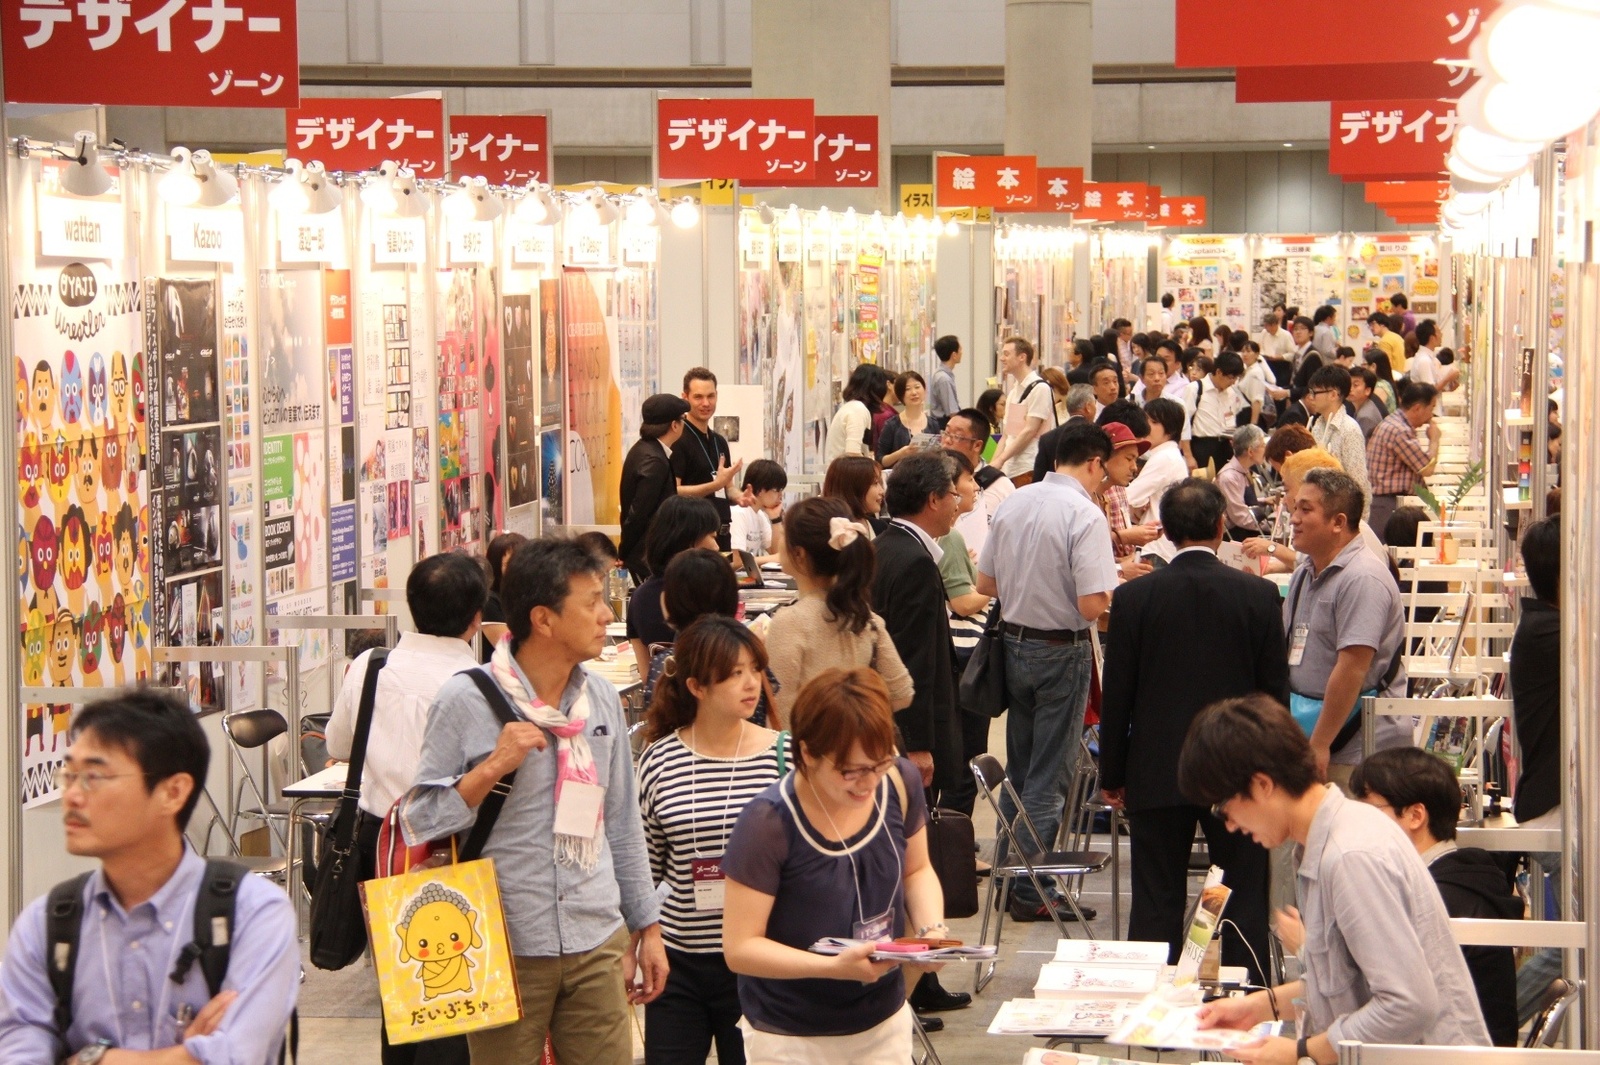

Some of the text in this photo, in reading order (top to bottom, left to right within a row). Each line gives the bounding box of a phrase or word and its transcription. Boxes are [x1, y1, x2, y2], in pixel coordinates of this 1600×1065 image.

[19, 0, 281, 53] デザイナー
[208, 69, 285, 96] ゾーン
[295, 116, 434, 151] デザイナー
[667, 117, 806, 151] デザイナー
[766, 159, 807, 174] ゾーン
[504, 168, 541, 182] ゾーン
[835, 169, 872, 182] ゾーン
[1005, 194, 1033, 205] ゾーン
[1055, 201, 1080, 212] ゾーン
[1123, 209, 1144, 219] ゾーン
[64, 215, 102, 244] wattan
[193, 222, 223, 249] Kazoo
[696, 863, 721, 875] メーカ
